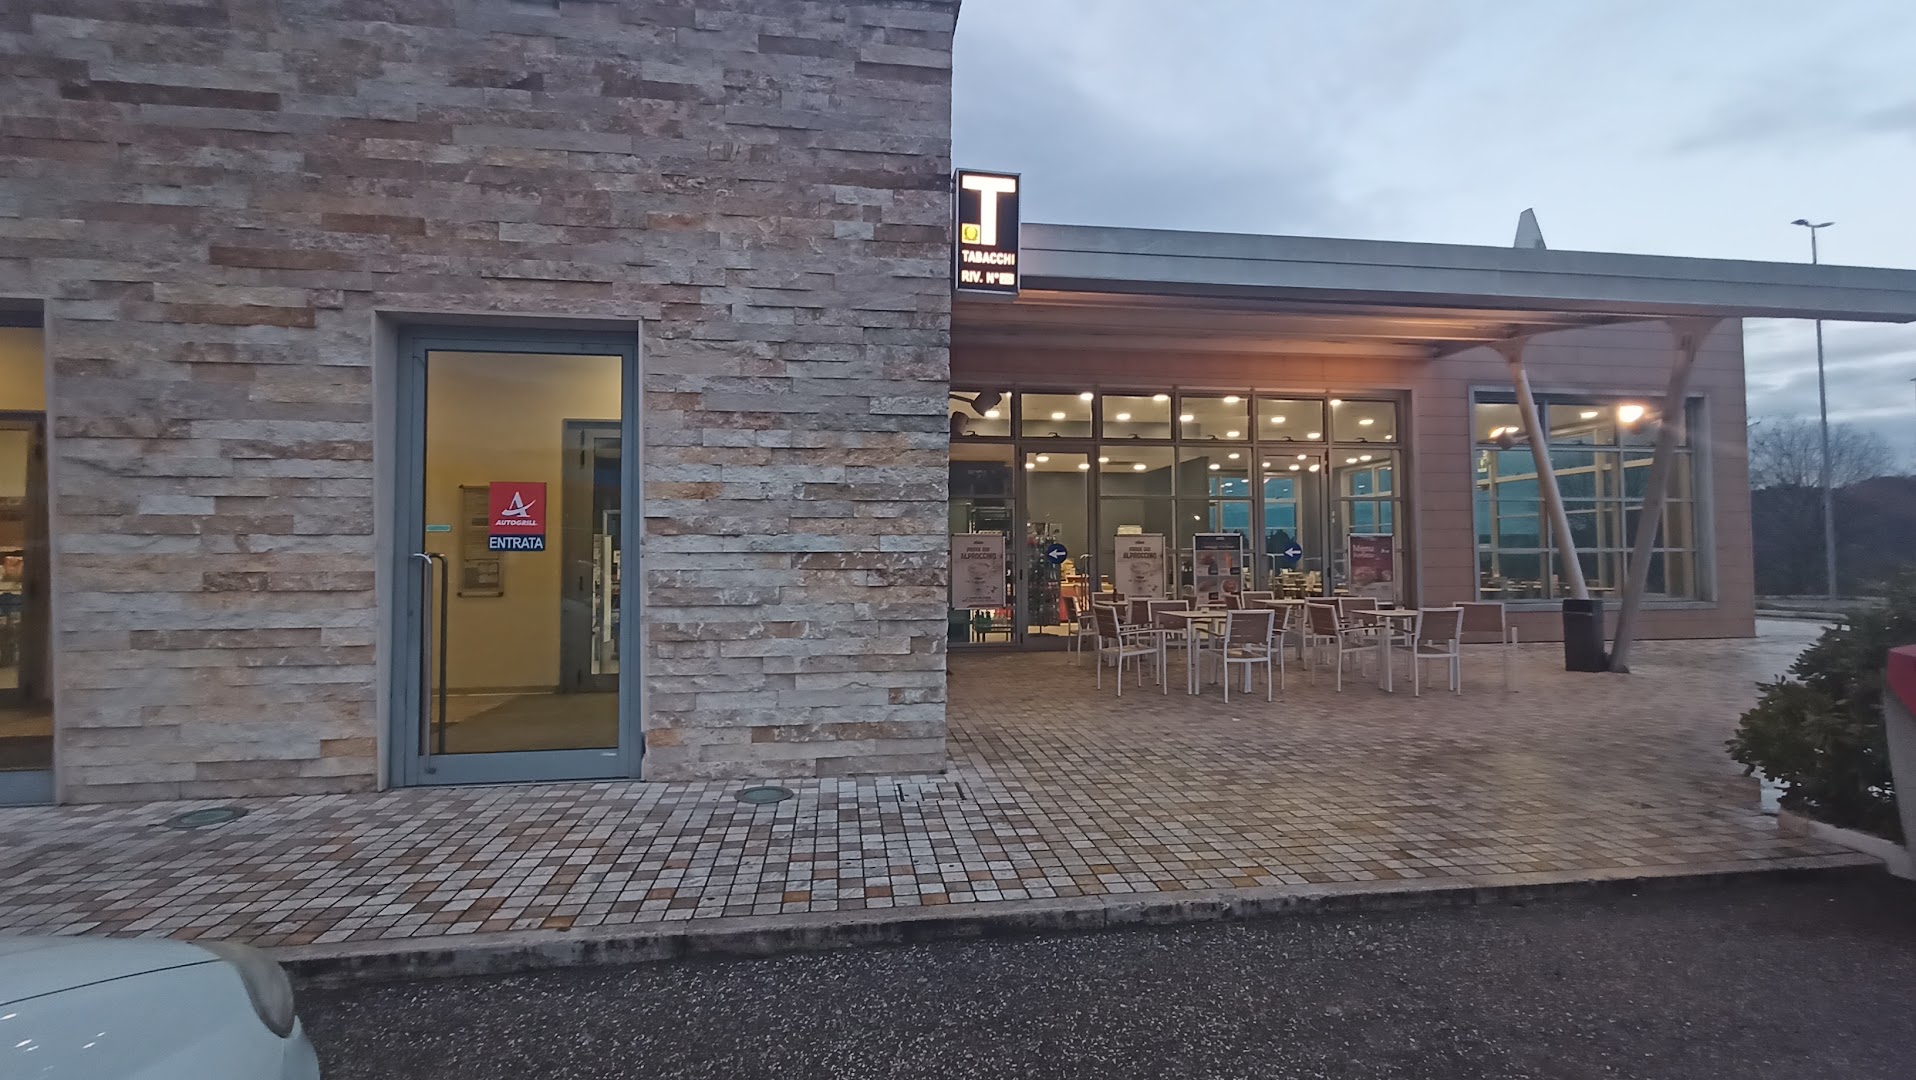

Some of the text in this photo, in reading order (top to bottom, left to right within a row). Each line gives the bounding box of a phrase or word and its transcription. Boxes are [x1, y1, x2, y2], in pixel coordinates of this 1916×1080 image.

[962, 175, 1016, 246] T
[961, 250, 1016, 266] TABACCHI
[961, 270, 983, 283] RIV.
[489, 536, 544, 549] ENTRATA
